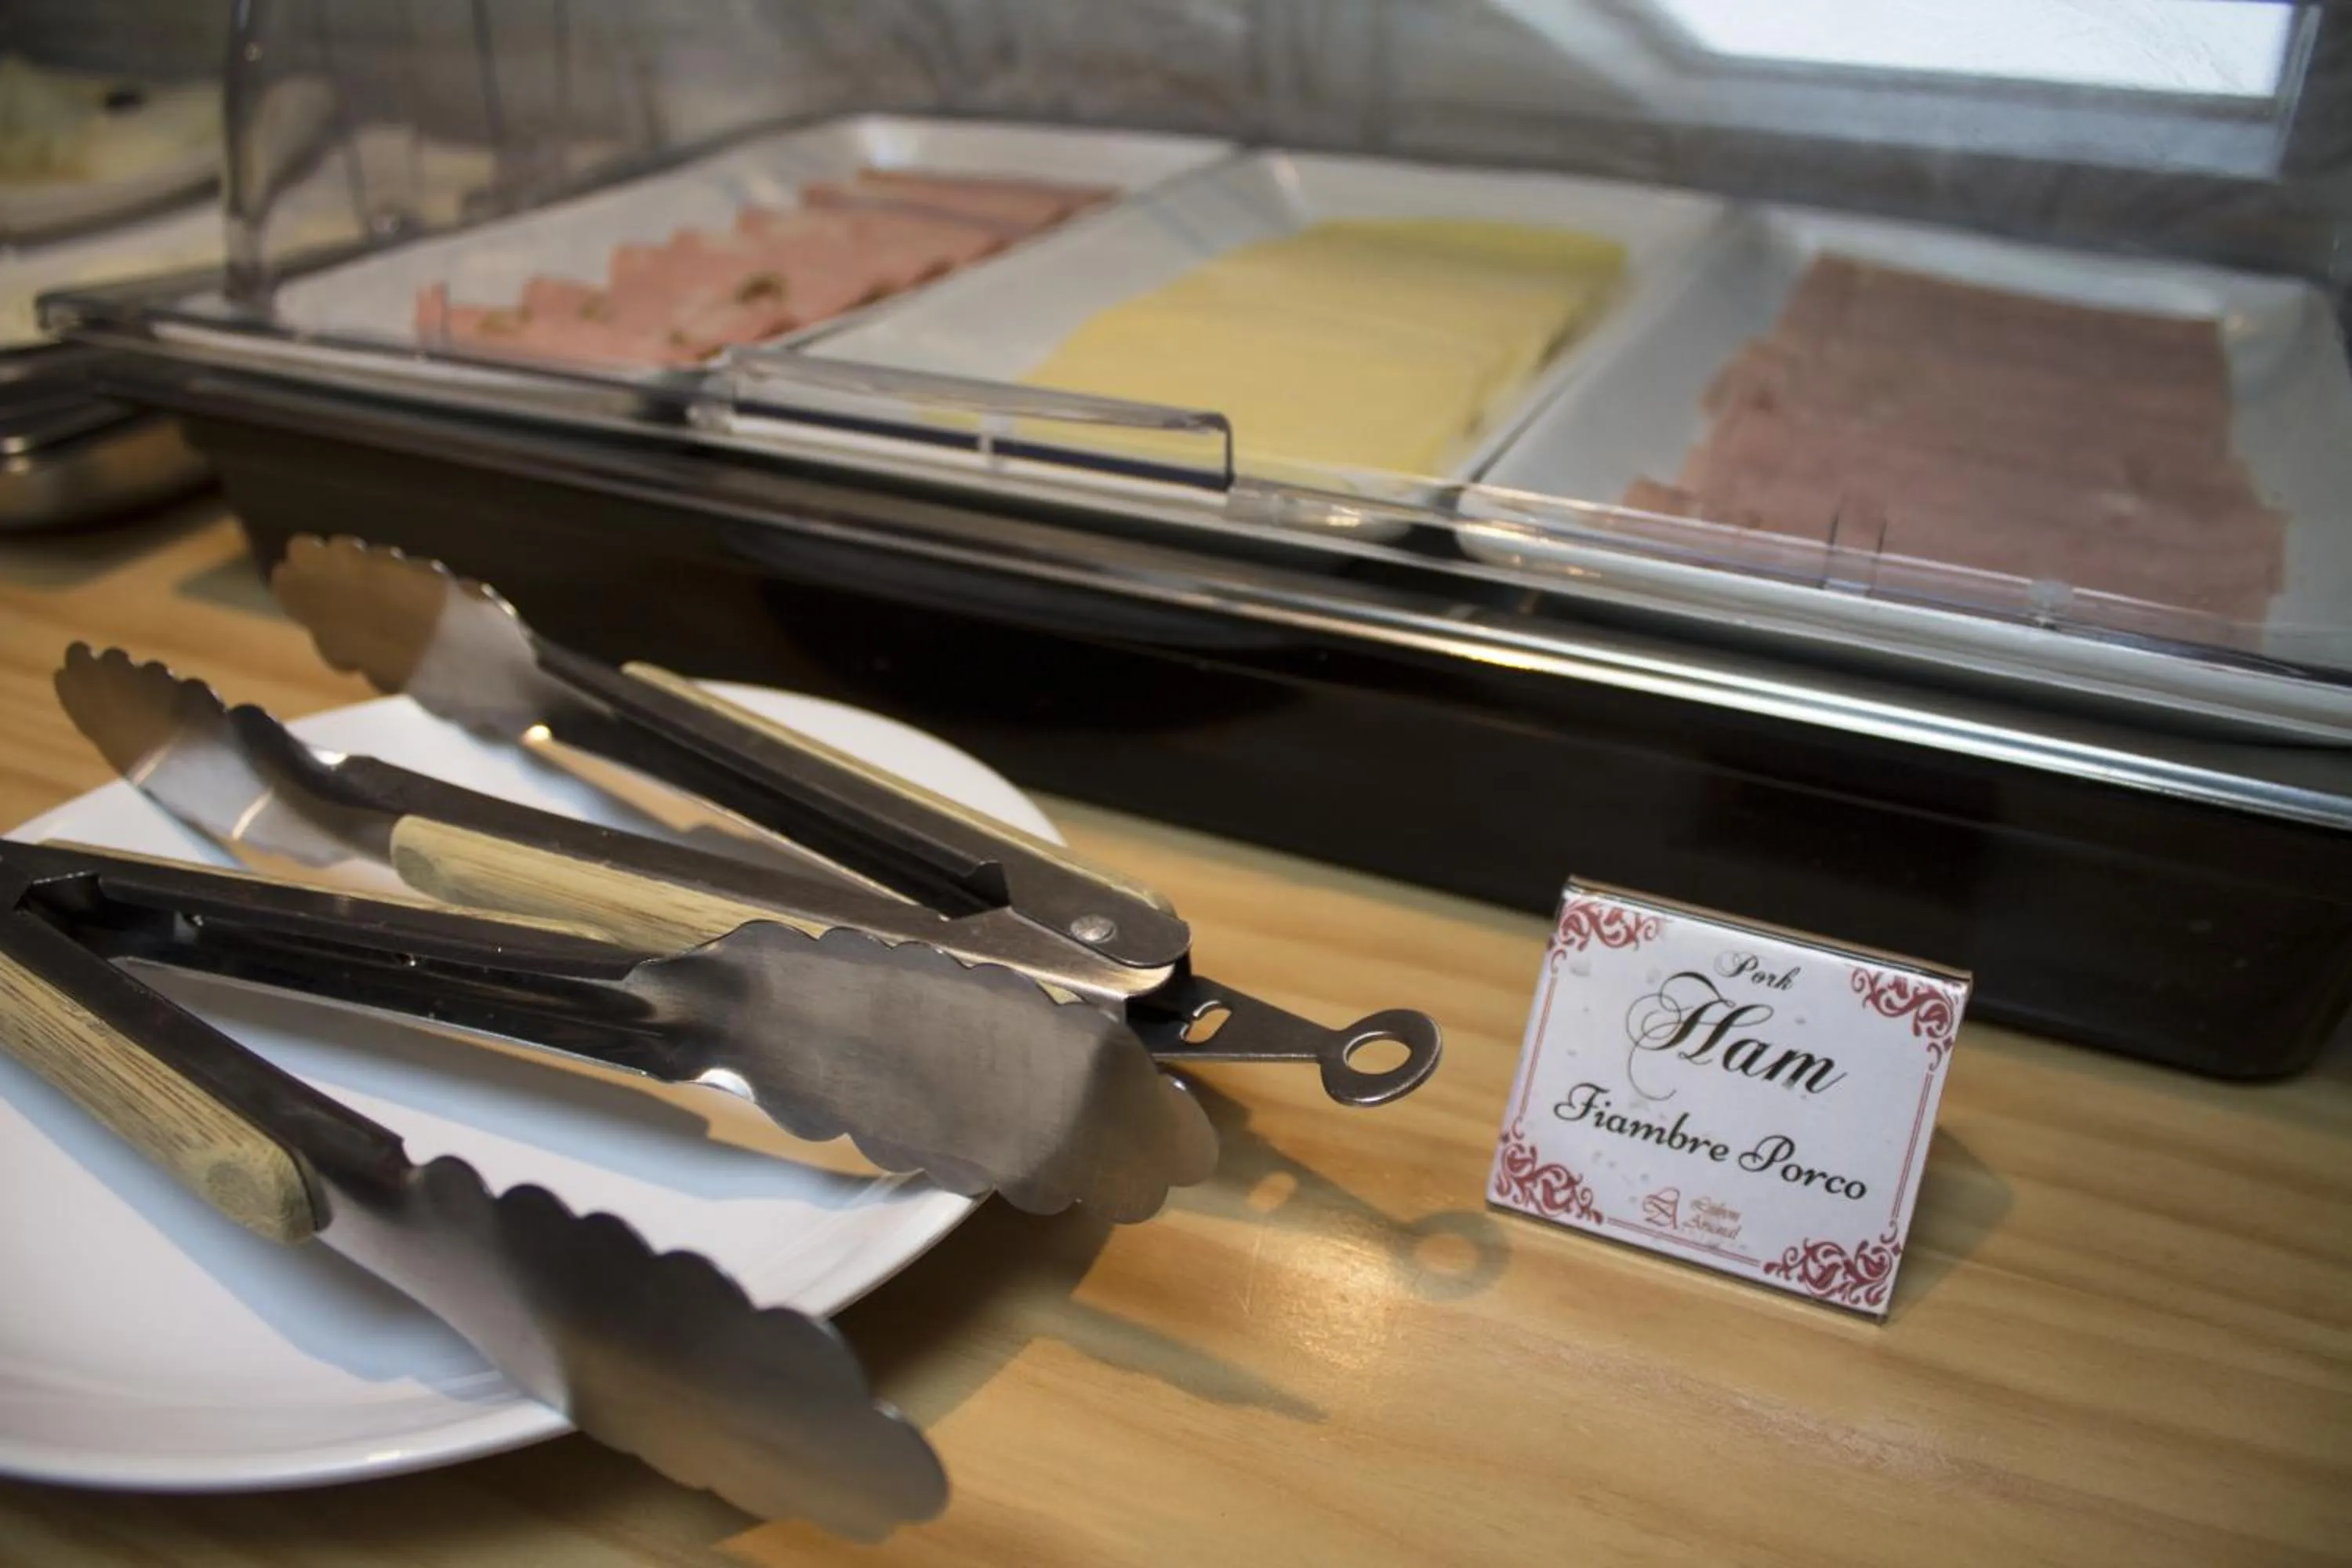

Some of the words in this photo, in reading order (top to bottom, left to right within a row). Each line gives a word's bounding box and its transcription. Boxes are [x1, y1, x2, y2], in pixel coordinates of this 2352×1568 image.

[1714, 950, 1801, 991] Pork
[1626, 971, 1848, 1101] Ham
[1553, 1083, 1730, 1162] Fiambre
[1738, 1134, 1867, 1200] Porco
